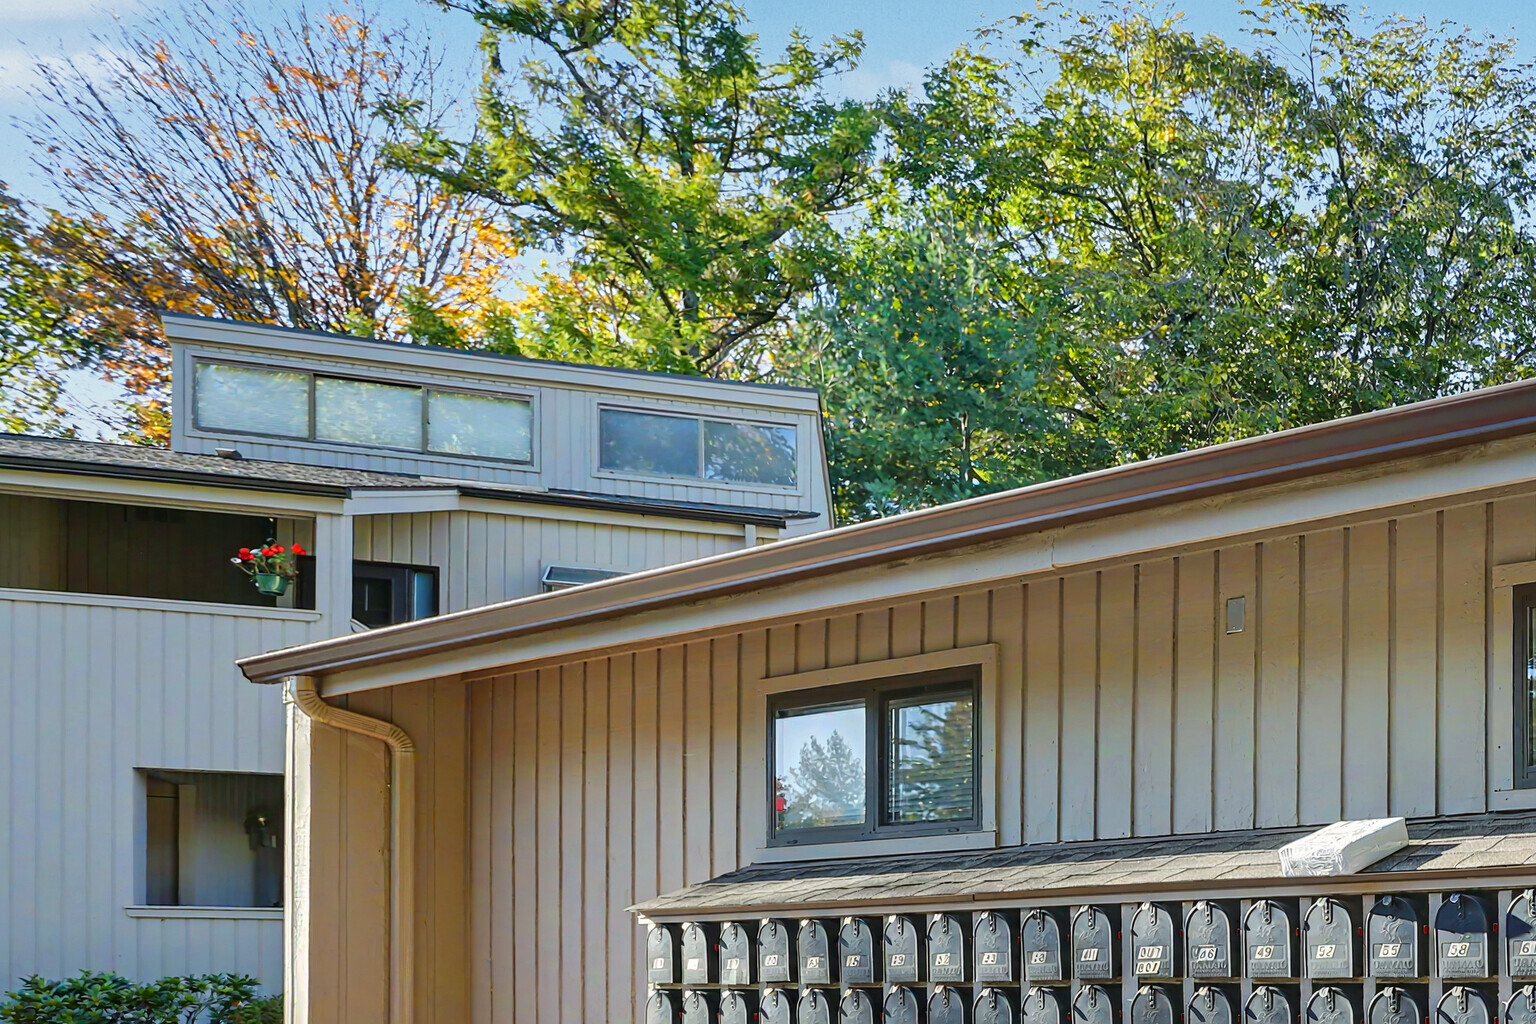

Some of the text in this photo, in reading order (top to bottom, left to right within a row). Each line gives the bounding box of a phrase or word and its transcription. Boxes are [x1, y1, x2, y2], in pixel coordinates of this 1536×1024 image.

[1257, 946, 1272, 958] 49
[1319, 945, 1334, 957] 52
[1451, 943, 1467, 955] 58
